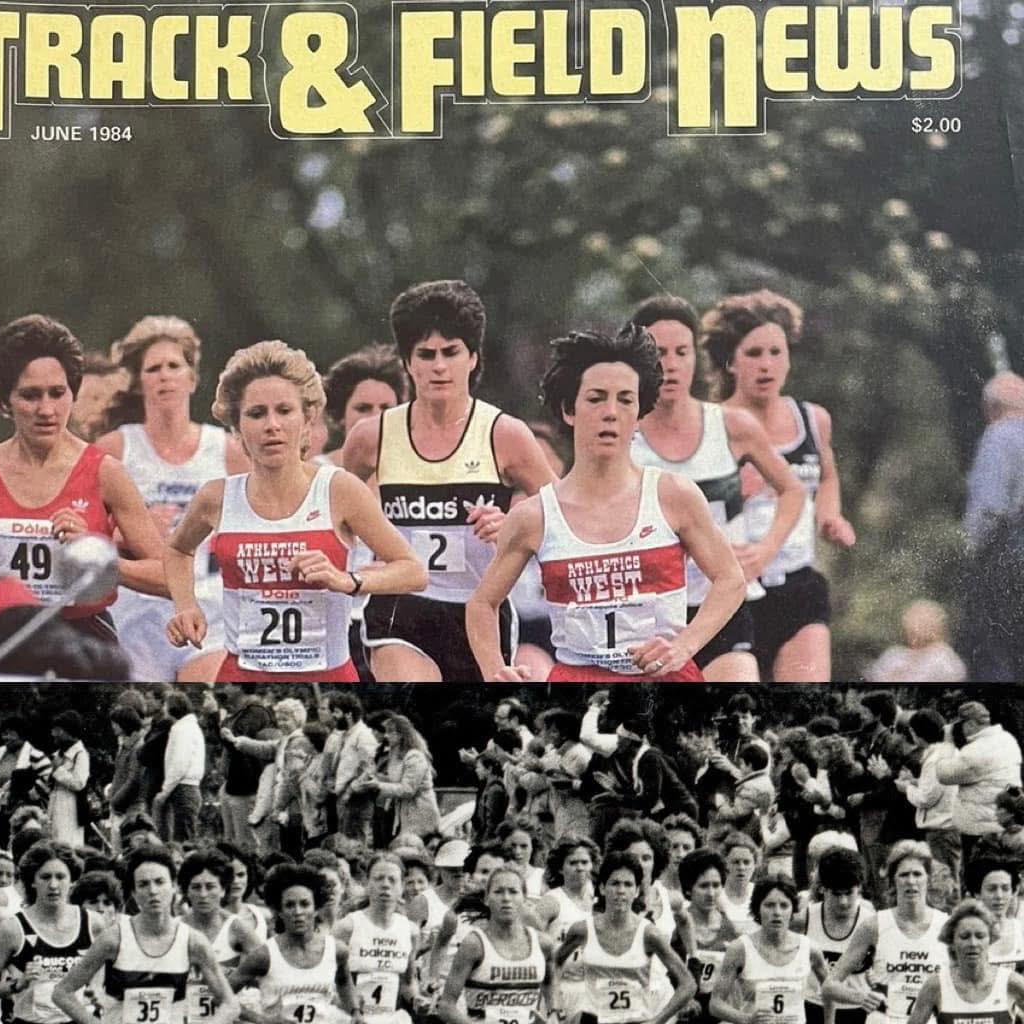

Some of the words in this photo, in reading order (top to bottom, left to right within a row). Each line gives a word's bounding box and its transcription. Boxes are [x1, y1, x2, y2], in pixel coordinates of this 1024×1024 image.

[384, 496, 458, 520] adidas
[10, 542, 52, 581] 49
[237, 542, 307, 558] ATHLETICS
[428, 533, 448, 571] 2
[237, 557, 307, 584] WES
[567, 555, 641, 578] ATHLETICS
[568, 570, 643, 602] WEST
[260, 607, 303, 646] 20
[604, 611, 616, 649] 1
[373, 938, 398, 947] new
[900, 950, 929, 961] new
[886, 962, 941, 973] balance
[371, 984, 383, 1005] 4
[608, 991, 631, 1010] 25
[773, 994, 785, 1014] 6
[136, 1000, 161, 1023] 35
[293, 1004, 316, 1024] 43
